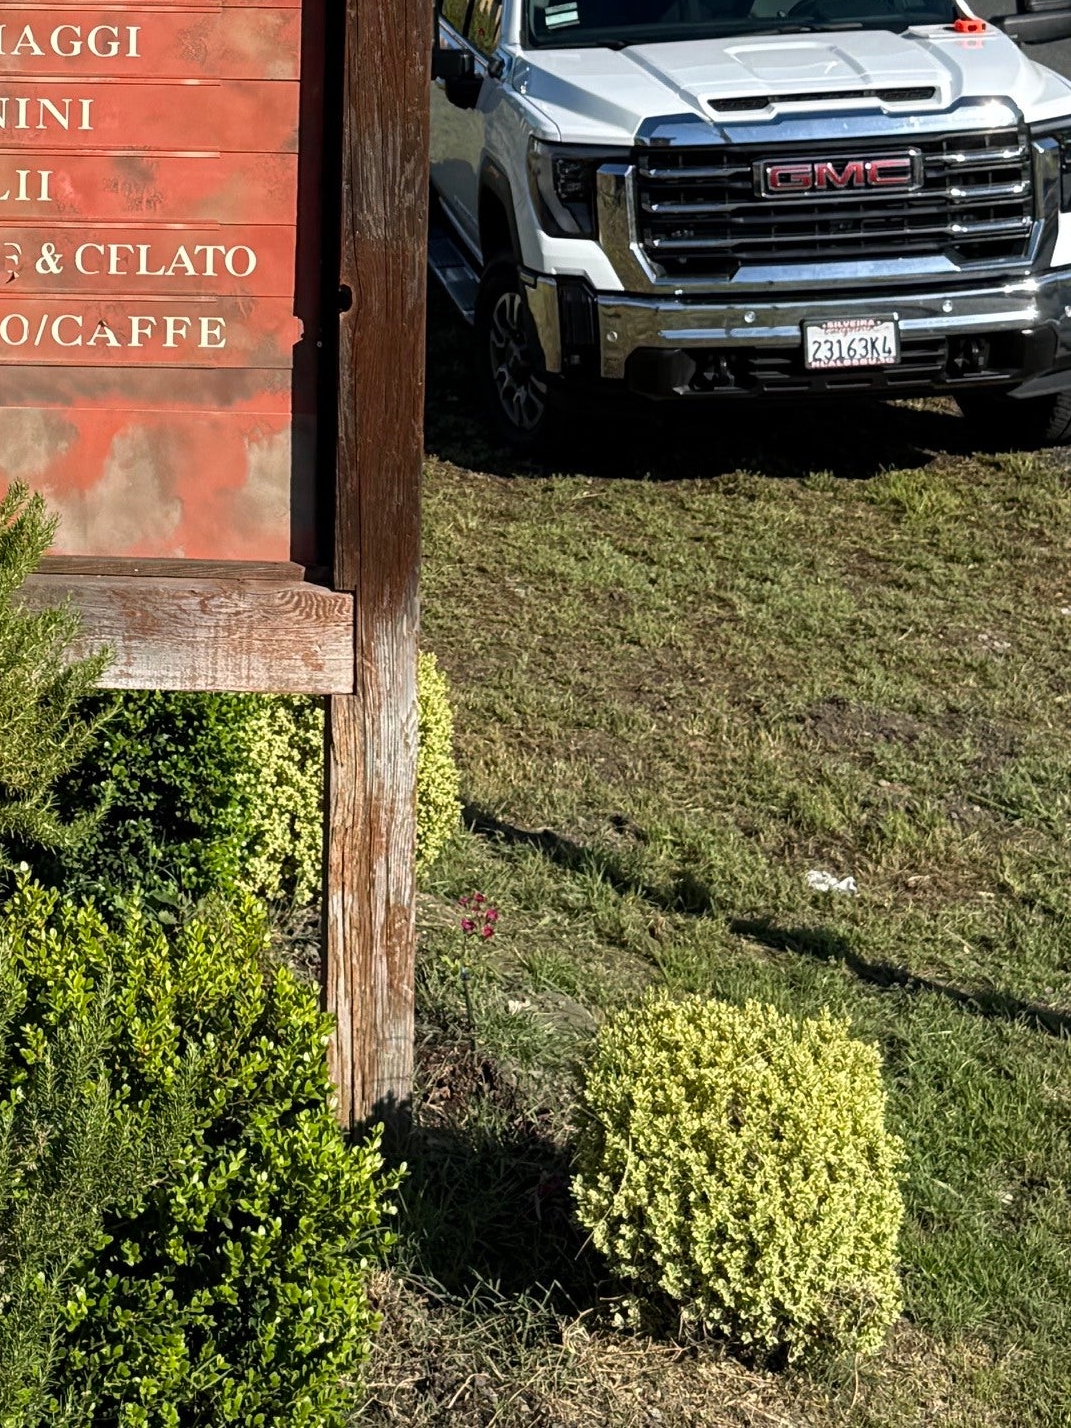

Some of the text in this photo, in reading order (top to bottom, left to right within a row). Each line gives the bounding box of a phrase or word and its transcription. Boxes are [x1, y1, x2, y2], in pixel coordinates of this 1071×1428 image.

[768, 158, 911, 191] GMC
[35, 242, 64, 275] &
[812, 335, 893, 362] 23163K4
